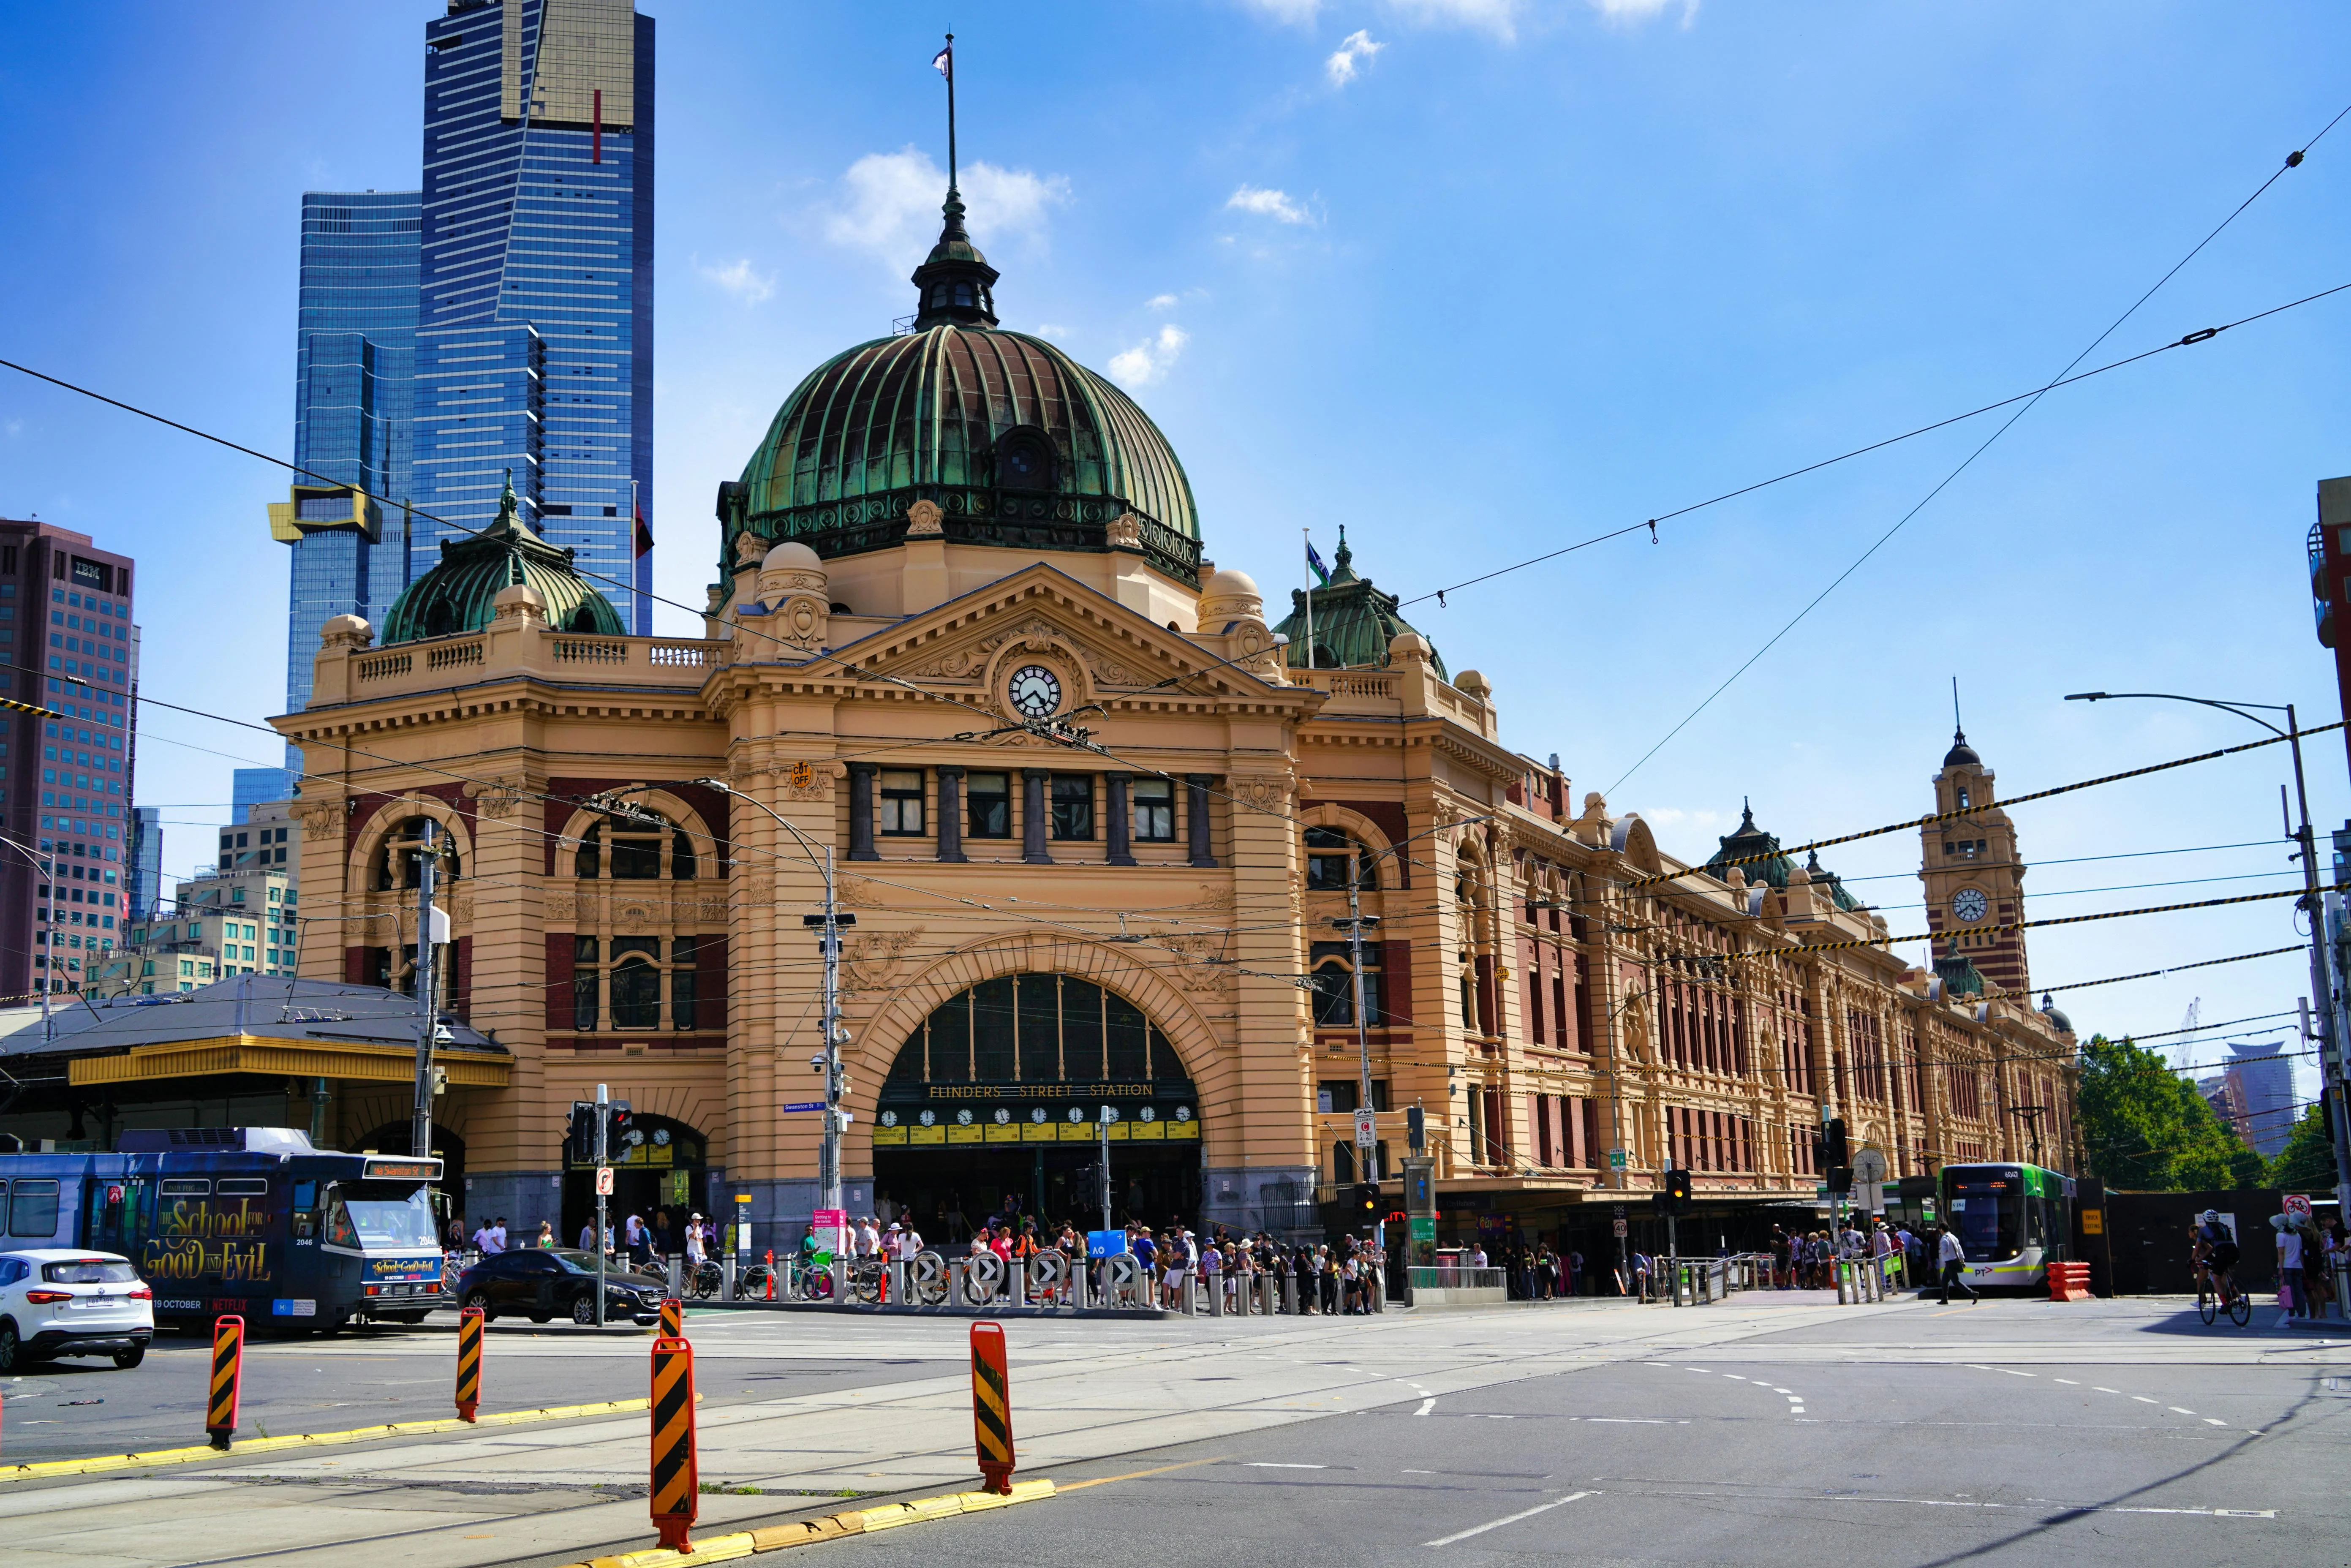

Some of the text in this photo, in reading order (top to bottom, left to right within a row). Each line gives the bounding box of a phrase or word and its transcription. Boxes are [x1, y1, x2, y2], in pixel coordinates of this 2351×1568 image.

[76, 562, 100, 579] IBM
[793, 765, 808, 774] CUT
[794, 776, 808, 784] OFF
[930, 1084, 1152, 1098] FLINDERS STREET STATION
[1363, 1123, 1368, 1131] C
[374, 1165, 433, 1176] via Swanston St 67
[166, 1198, 249, 1249] School
[247, 1211, 263, 1225] FOR
[419, 1236, 436, 1245] 2046
[204, 1256, 221, 1269] AND
[154, 1298, 247, 1312] 19 OCTOBER NETFLIX
